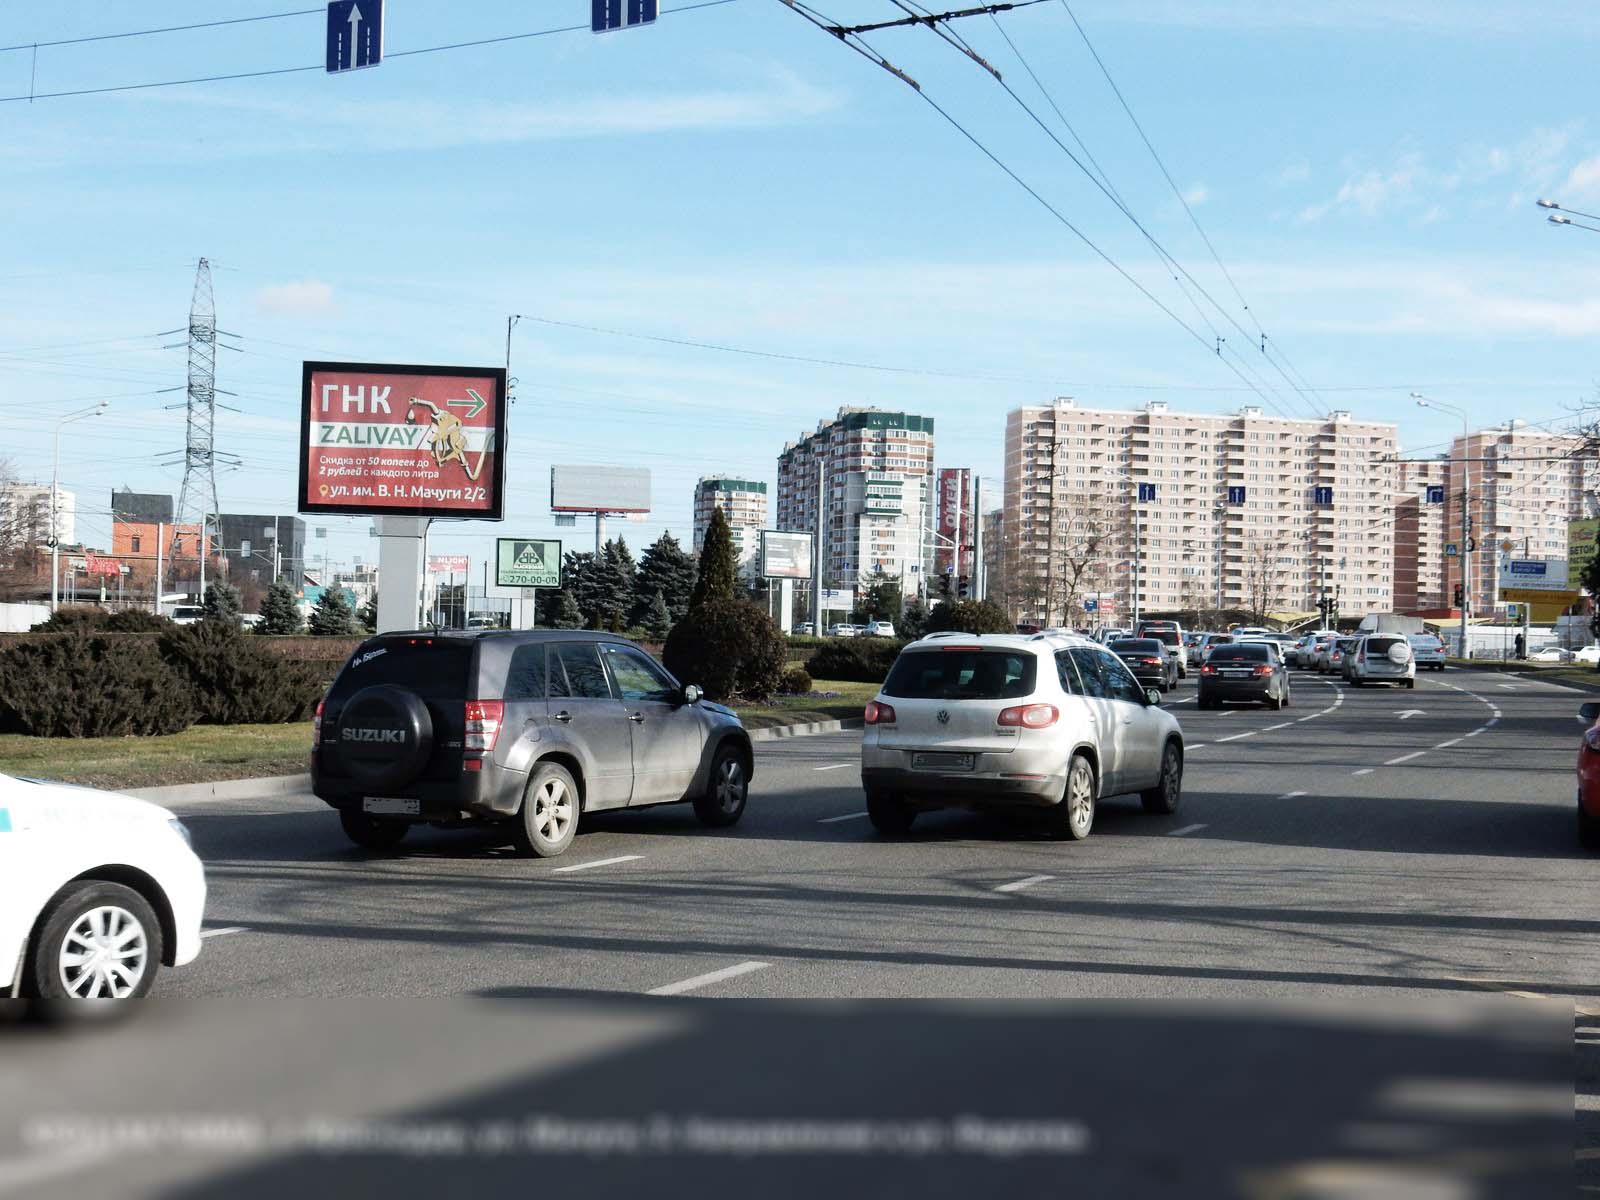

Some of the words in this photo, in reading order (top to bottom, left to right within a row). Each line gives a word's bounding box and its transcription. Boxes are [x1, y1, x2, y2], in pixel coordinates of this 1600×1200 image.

[321, 384, 392, 414] ГНК
[320, 424, 417, 445] ZALIVAY
[319, 455, 354, 467] Скидка
[356, 457, 366, 466] от
[367, 457, 380, 466] 50
[381, 458, 415, 467] копеек
[416, 459, 429, 468] до
[319, 466, 326, 475] 2
[327, 465, 362, 477] рублей
[363, 469, 369, 477] с
[370, 469, 410, 479] каждого
[411, 470, 440, 479] литра
[329, 486, 350, 499] ул.
[352, 486, 375, 497] им.
[378, 485, 391, 497] В.
[394, 486, 408, 498] Н.
[411, 486, 461, 500] Мачуги
[464, 486, 487, 501] 2/2
[341, 728, 405, 743] SUZUKI
